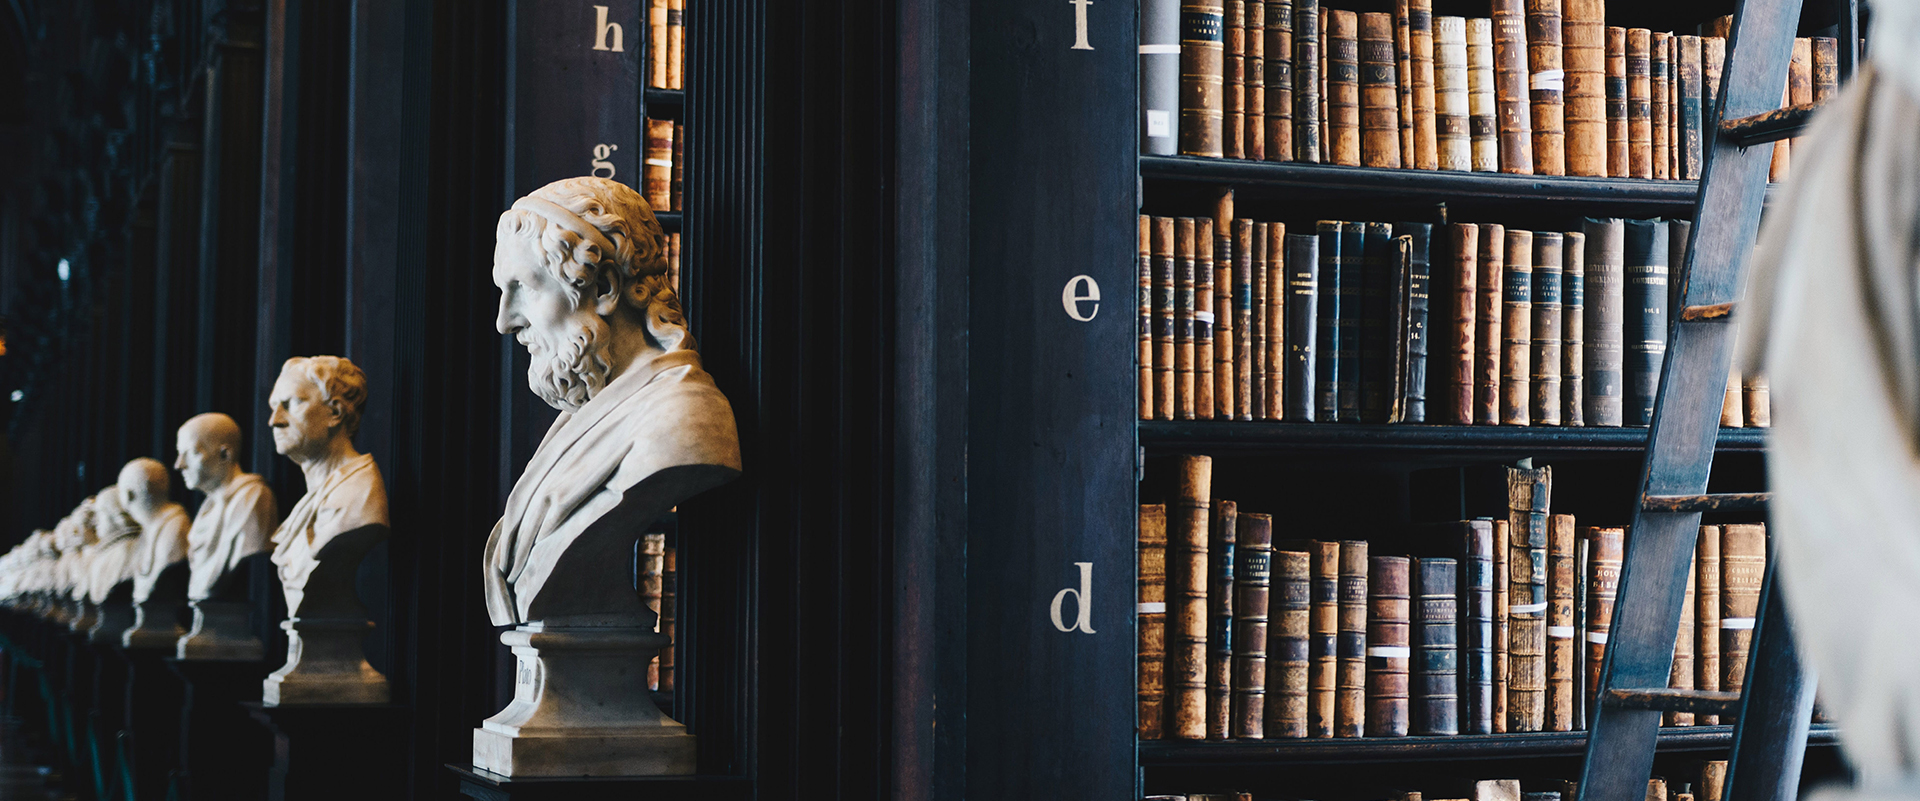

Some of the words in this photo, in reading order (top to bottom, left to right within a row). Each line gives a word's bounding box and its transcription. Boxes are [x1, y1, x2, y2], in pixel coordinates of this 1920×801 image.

[592, 5, 625, 52] h
[590, 143, 619, 180] g
[1062, 274, 1101, 322] e
[1592, 580, 1618, 589] BIBL
[1597, 569, 1619, 578] HOLY
[1050, 561, 1097, 634] d
